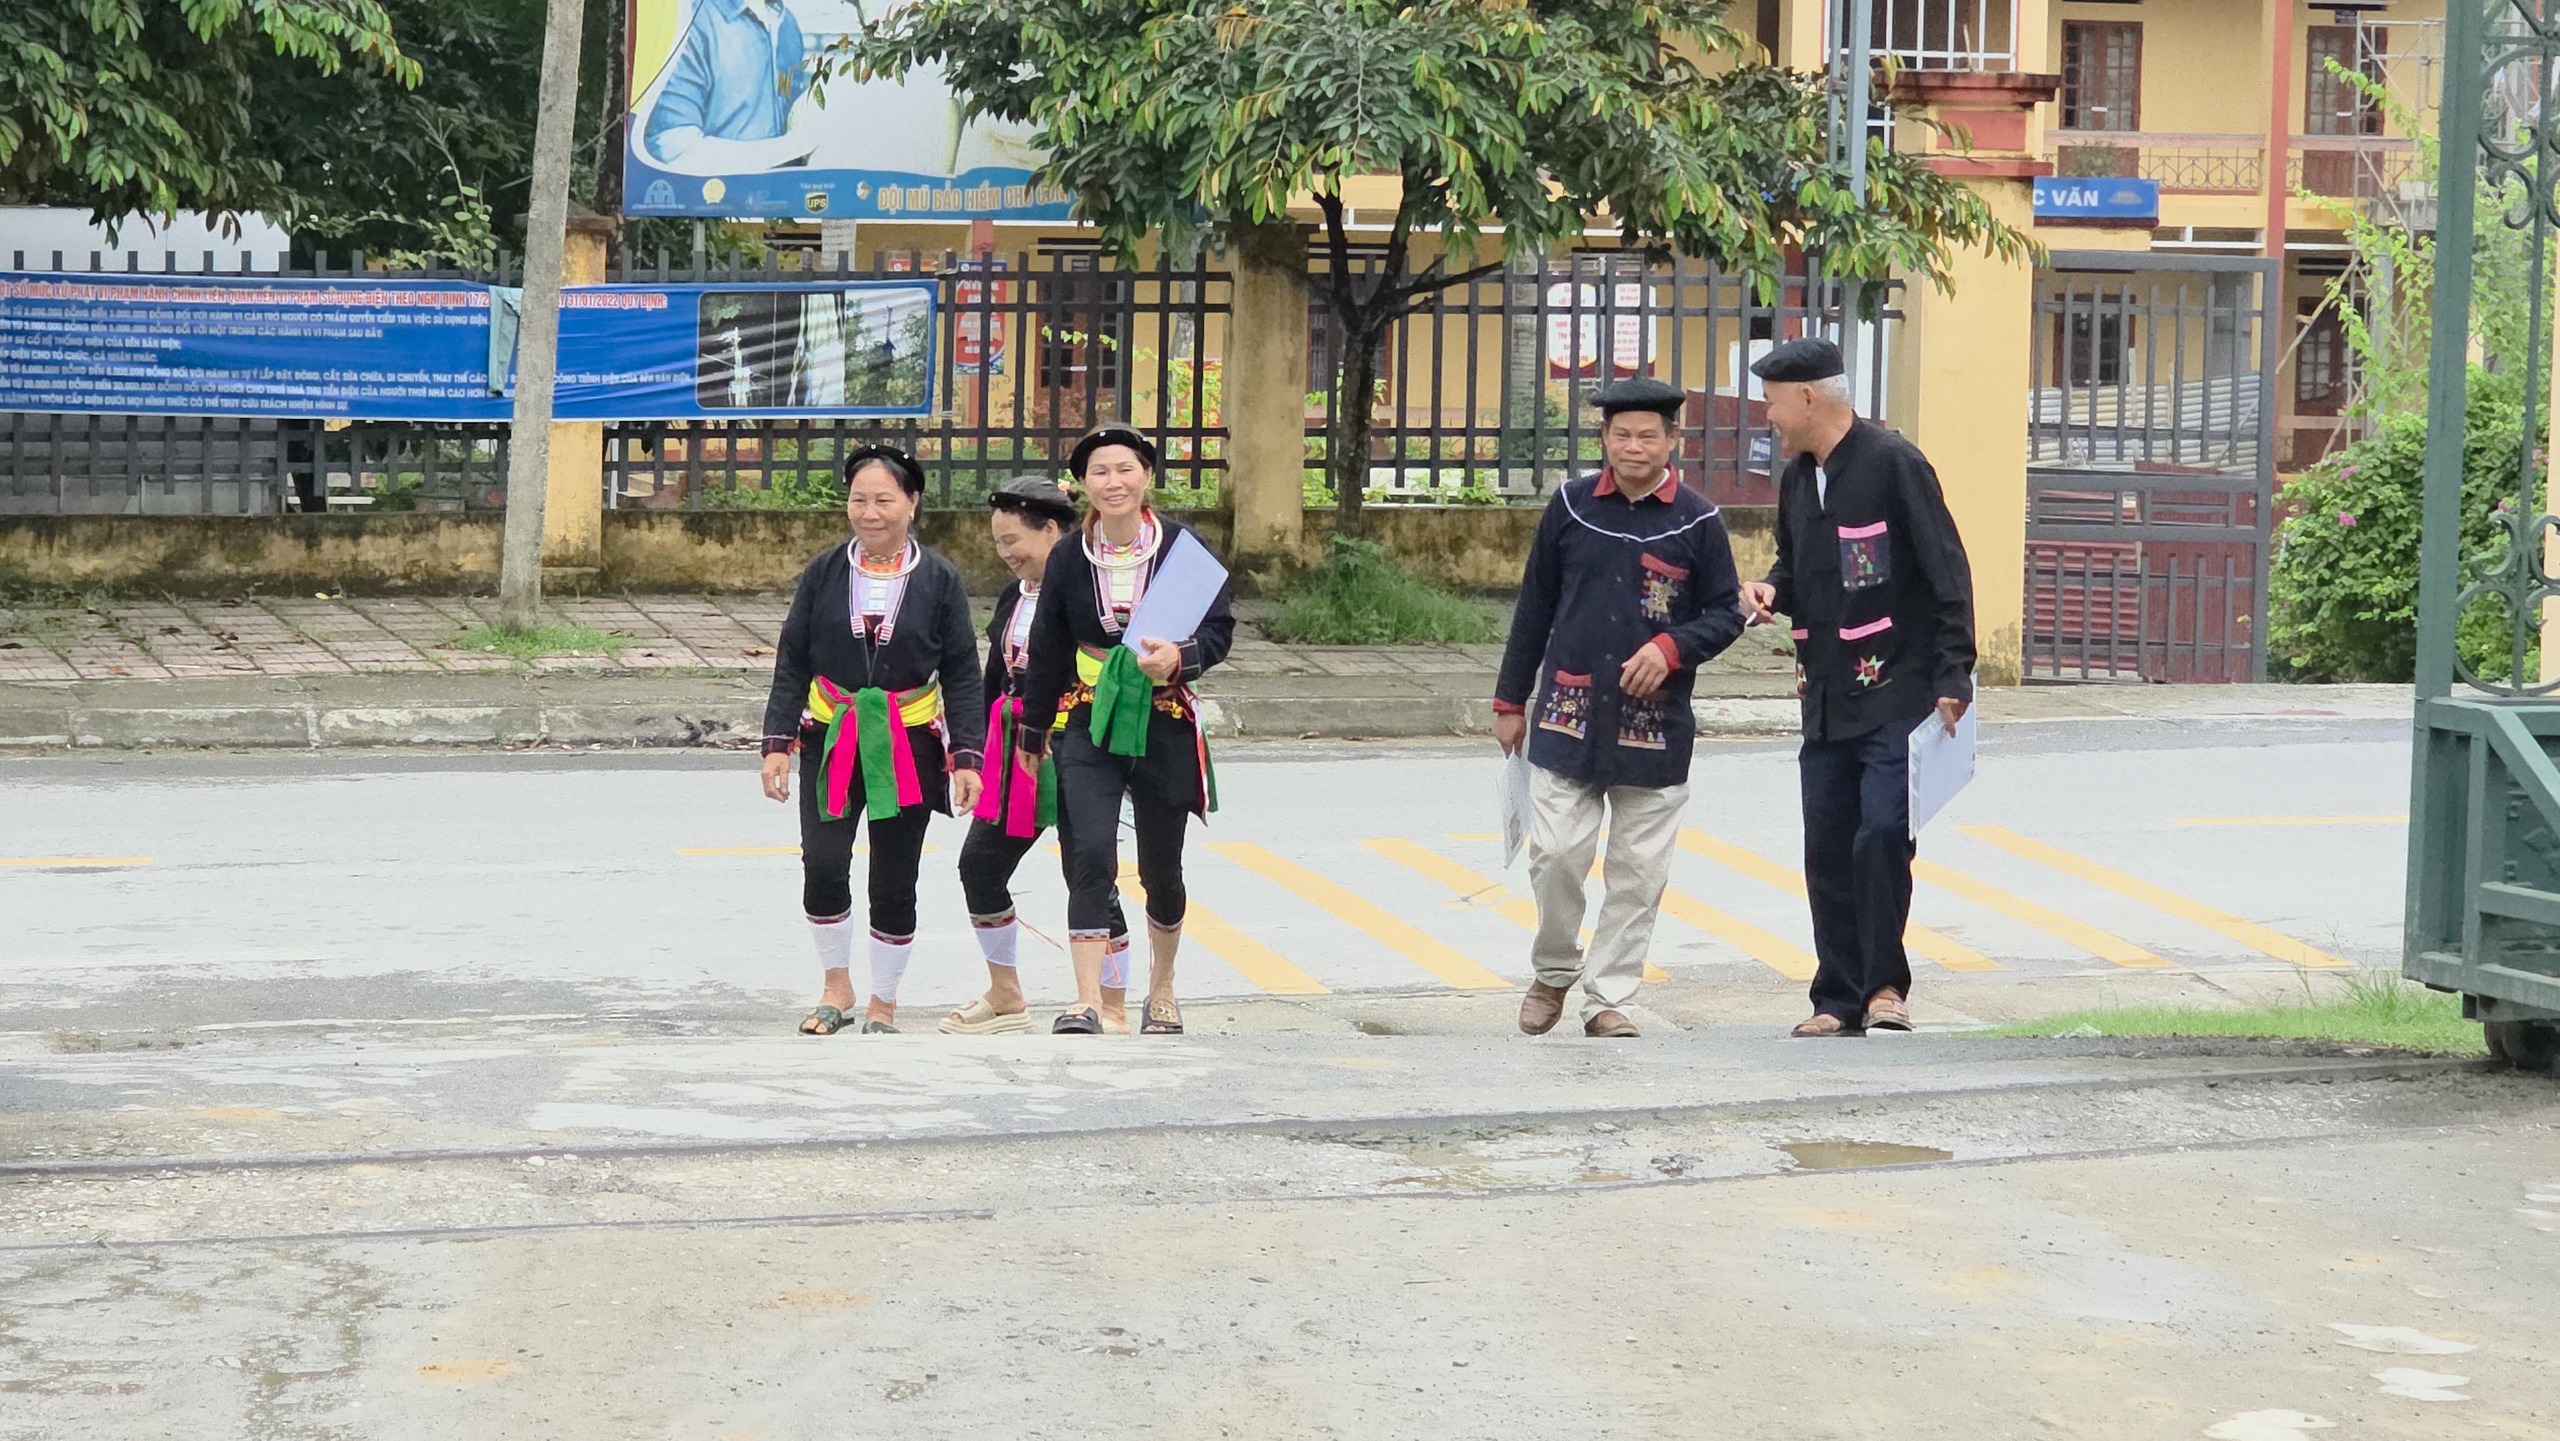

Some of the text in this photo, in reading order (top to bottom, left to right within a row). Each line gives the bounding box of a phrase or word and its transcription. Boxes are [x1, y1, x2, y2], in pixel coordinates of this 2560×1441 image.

[806, 198, 827, 208] UPS
[877, 183, 904, 215] ĐỘI
[905, 184, 930, 211] MŨ
[932, 180, 962, 212] BẢO
[964, 180, 1002, 211] HIỂM
[2051, 186, 2099, 207] VĂN
[0, 279, 12, 300] ỘT
[13, 278, 28, 298] SỐ
[70, 284, 96, 303] PHẠT
[98, 285, 109, 300] VI
[109, 285, 140, 303] PHẠM
[141, 284, 170, 302] HÀNH
[228, 287, 255, 305] QUAN
[321, 286, 337, 305] SỬ
[337, 290, 364, 308] DỤNG
[389, 290, 415, 307] THEO
[415, 291, 441, 309] NGHỊ
[441, 291, 467, 309] ĐỊNH
[567, 293, 619, 309] 31/01/2022
[620, 293, 641, 310] QUY
